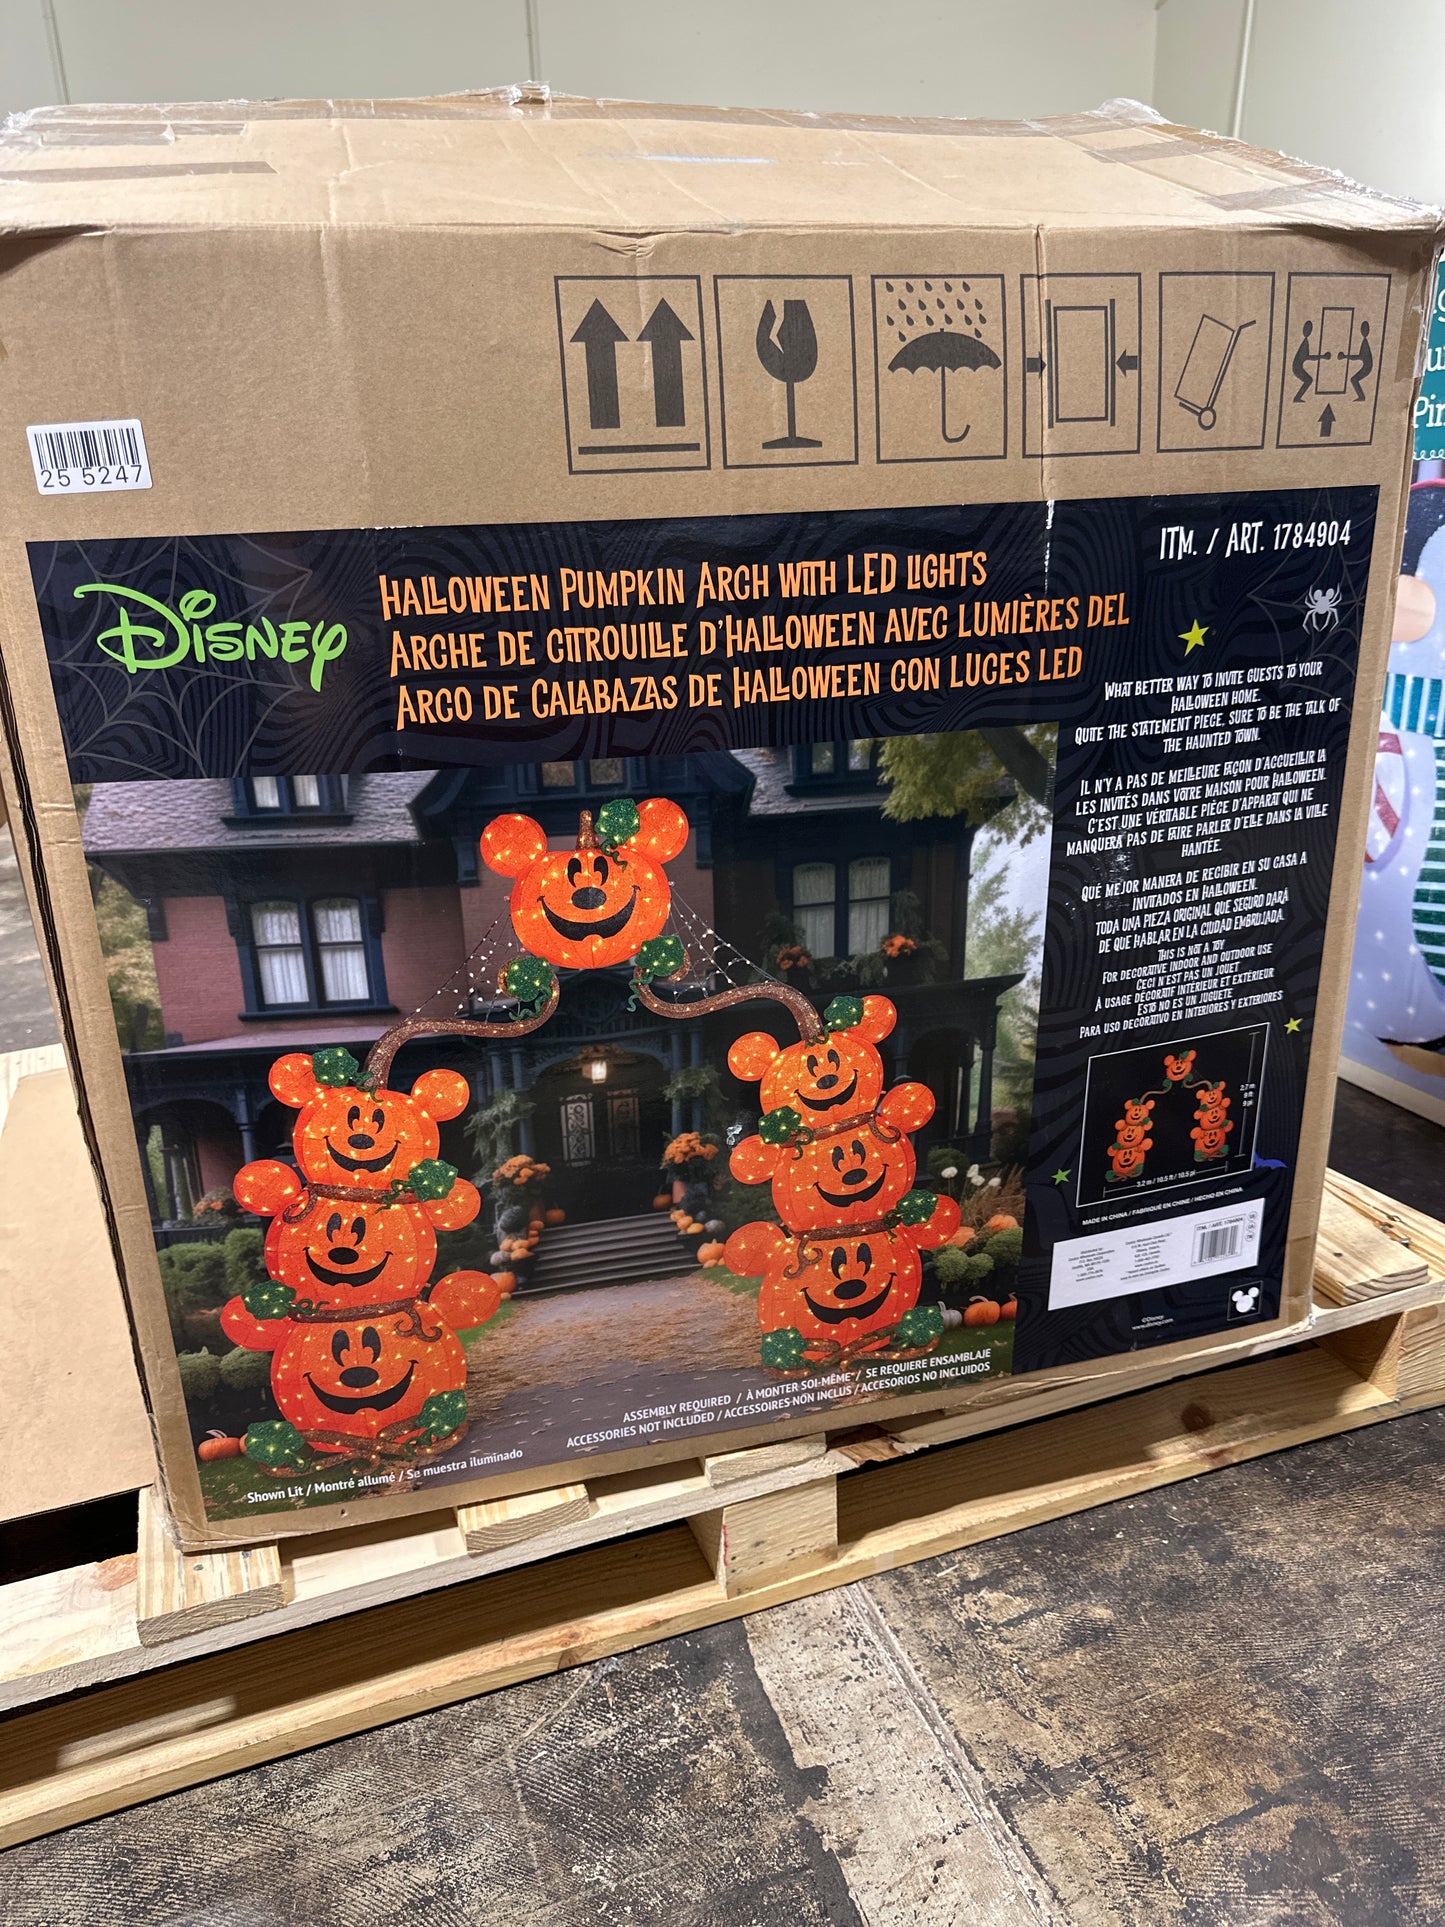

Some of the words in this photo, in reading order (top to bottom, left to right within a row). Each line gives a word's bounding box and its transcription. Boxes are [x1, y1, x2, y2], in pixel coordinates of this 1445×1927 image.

[41, 470, 70, 487] 25
[82, 465, 142, 485] 5247
[1160, 525, 1198, 560] ITM.
[1206, 528, 1219, 554] /
[1225, 521, 1265, 558] ART.
[1273, 520, 1351, 550] 1784904
[379, 574, 550, 621] HALLOWEEN
[560, 567, 684, 612] PUMPKIN
[697, 561, 769, 608] ARCH
[778, 560, 836, 598] WITH
[848, 552, 897, 595] LED
[907, 551, 988, 590] LIGHTS
[390, 630, 487, 678] ARCHE
[498, 630, 535, 666] DE
[547, 622, 688, 663] CITROUILLE
[700, 611, 875, 657] D'HALLOWEEN
[884, 605, 948, 643] AVEC
[958, 593, 1079, 638] LUMIÈRES
[1088, 592, 1130, 628] DEL
[397, 685, 472, 731] ARCO
[483, 685, 520, 720] DE
[531, 675, 679, 719] CALABAZAS
[688, 673, 722, 708] DE
[733, 662, 880, 708] HALLOWEEN
[891, 657, 940, 693] CON
[950, 649, 1030, 688] LUCES
[1039, 646, 1083, 680] LED
[1105, 682, 1133, 700] WHAT
[1135, 678, 1173, 696] BETTER
[1177, 675, 1199, 692] WAY
[1202, 673, 1212, 688] TO
[1215, 671, 1244, 687] INVITE
[1247, 666, 1283, 684] GUESTS
[1287, 664, 1296, 677] TO
[1299, 661, 1323, 677] YOUR
[1171, 689, 1228, 713] HALLOWEEN
[1231, 689, 1261, 705] HOME.
[1075, 727, 1105, 745] QUITE
[1108, 724, 1128, 740] THE
[1132, 716, 1192, 737] STATEMENT
[1194, 713, 1225, 730] PIECE,
[1229, 708, 1253, 725] SURE
[1257, 707, 1266, 720] TO
[1269, 706, 1282, 720] BE
[1285, 703, 1302, 718] THE
[1304, 700, 1326, 716] TALK
[1329, 698, 1341, 711] OF
[1163, 738, 1182, 753] THE
[1186, 732, 1231, 751] HAUNTED
[1235, 728, 1261, 742] TOWN.
[1081, 883, 1102, 902] QUÉ
[1105, 880, 1139, 898] MEJOR
[1142, 873, 1182, 892] MANERA
[1186, 870, 1199, 884] DE
[1202, 862, 1240, 881] RECIBIR
[1242, 861, 1255, 875] EN
[1258, 858, 1271, 871] SU
[1273, 853, 1297, 869] CASA
[1300, 851, 1307, 864] A
[1132, 890, 1183, 911] INVITADOS
[1185, 888, 1199, 902] EN
[1201, 878, 1258, 900] HALLOWEEN.
[1102, 971, 1118, 984] FOR
[1120, 964, 1168, 980] DECORATIVE
[1170, 957, 1199, 971] INDOOR
[1201, 954, 1218, 966] AND
[1220, 947, 1255, 962] OUTDOOR
[1257, 943, 1273, 954] USE
[1158, 949, 1175, 961] THIS
[1177, 947, 1185, 958] IS
[1188, 944, 1202, 955] NOT
[1204, 942, 1209, 953] A
[1212, 940, 1226, 951] TOY
[566, 1426, 637, 1448] ACCESSORIES
[639, 1422, 661, 1434] NOT
[663, 1412, 715, 1430] INCLUDED
[716, 1411, 722, 1421] /
[724, 1397, 790, 1419] ACCESSOIRES
[792, 1393, 815, 1405] NON
[816, 1386, 851, 1400] INCLUS
[854, 1384, 860, 1395] /
[861, 1374, 920, 1392] ACCESORIOS
[923, 1371, 937, 1381] NO
[940, 1361, 991, 1379] INCLUIDOS
[623, 1404, 678, 1423] ASSEMBLY
[679, 1395, 731, 1414] REQUIRED
[736, 1393, 742, 1403] /
[746, 1389, 754, 1400] À
[755, 1382, 798, 1400] MONTER
[801, 1373, 851, 1390] SOI-MÊME
[856, 1371, 860, 1381] /
[865, 1369, 877, 1378] SE
[880, 1360, 927, 1375] REQUIERE
[930, 1349, 991, 1367] ENSAMBLAJE
[247, 1489, 285, 1503] Shown
[288, 1486, 304, 1498] Lit
[306, 1484, 311, 1497] /
[314, 1478, 355, 1493] Montré
[357, 1473, 395, 1487] allumé
[399, 1470, 403, 1482] /
[406, 1469, 420, 1480] Se
[423, 1461, 467, 1477] muestra
[470, 1449, 523, 1468] iluminado
